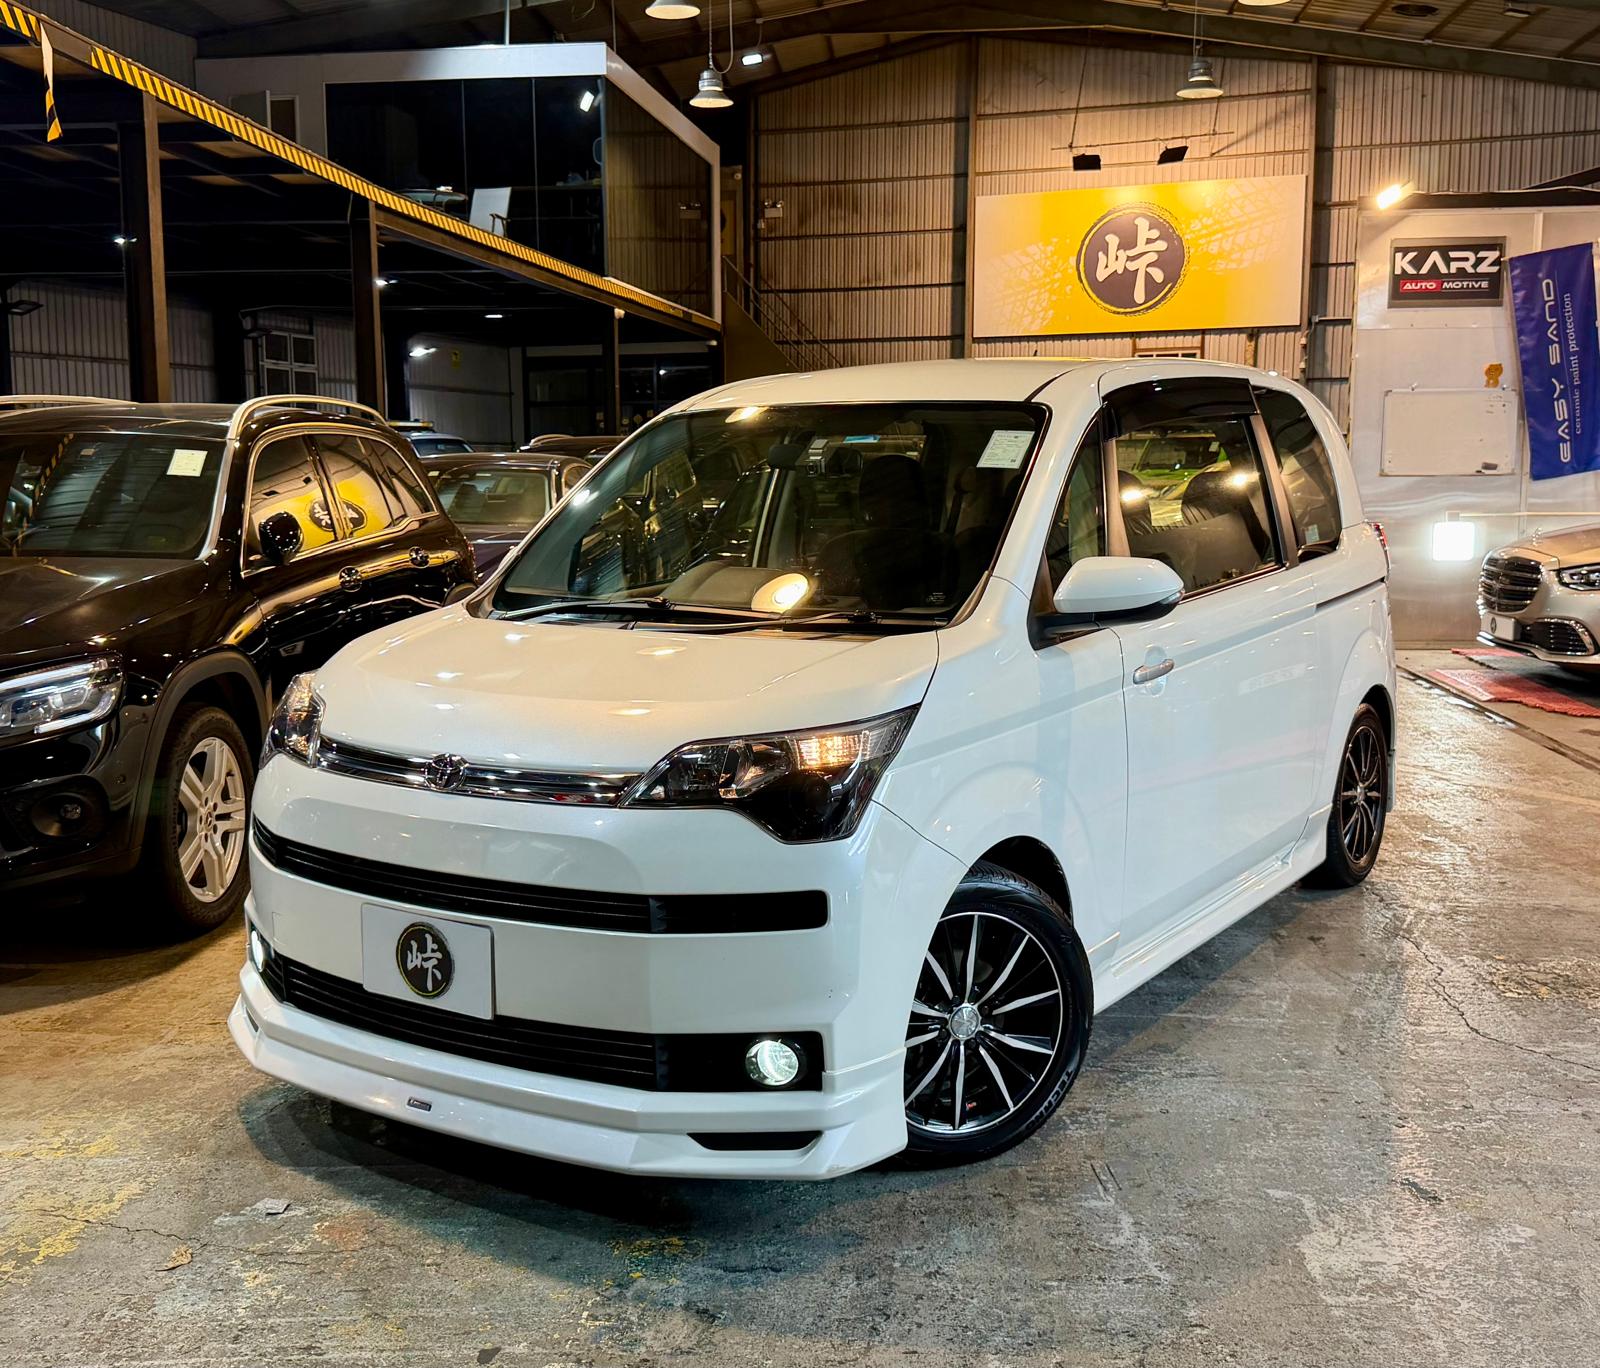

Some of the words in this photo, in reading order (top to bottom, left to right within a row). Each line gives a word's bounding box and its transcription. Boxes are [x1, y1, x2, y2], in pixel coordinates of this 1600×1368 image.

[1096, 216, 1168, 304] 峠
[1394, 250, 1500, 275] KARZ
[1402, 281, 1437, 290] AUTO
[1442, 280, 1489, 289] MOTIVE
[1542, 279, 1560, 366] SAND
[1563, 292, 1579, 352] protection
[1569, 354, 1581, 385] paint
[1551, 377, 1571, 462] EASY
[1573, 388, 1582, 434] ceramic
[407, 933, 442, 991] 峠
